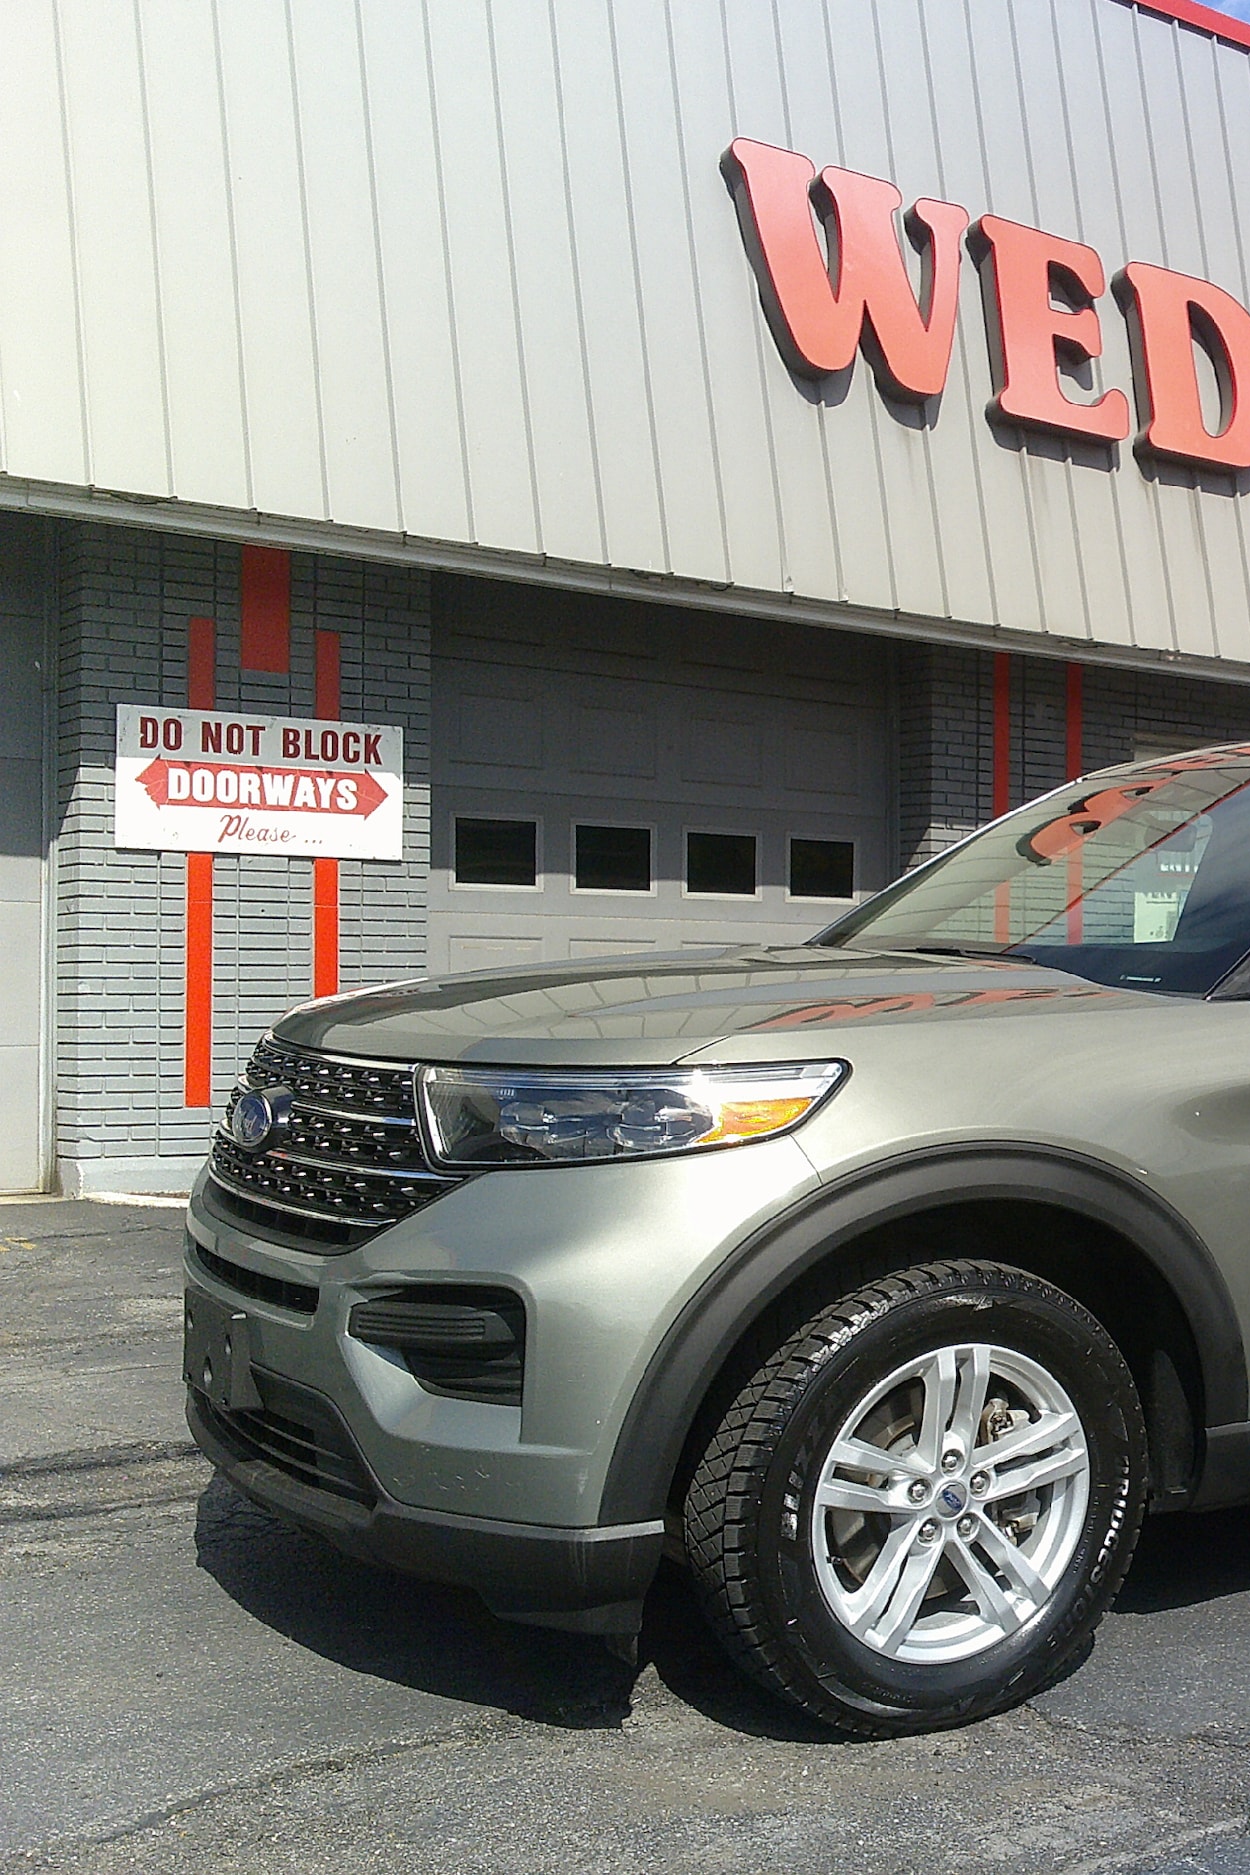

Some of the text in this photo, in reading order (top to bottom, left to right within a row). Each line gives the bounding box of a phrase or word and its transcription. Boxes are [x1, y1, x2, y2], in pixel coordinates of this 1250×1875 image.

[139, 716, 383, 766] DO NOT BLOCK
[167, 766, 359, 811] DOORWAYS
[217, 814, 298, 844] Please
